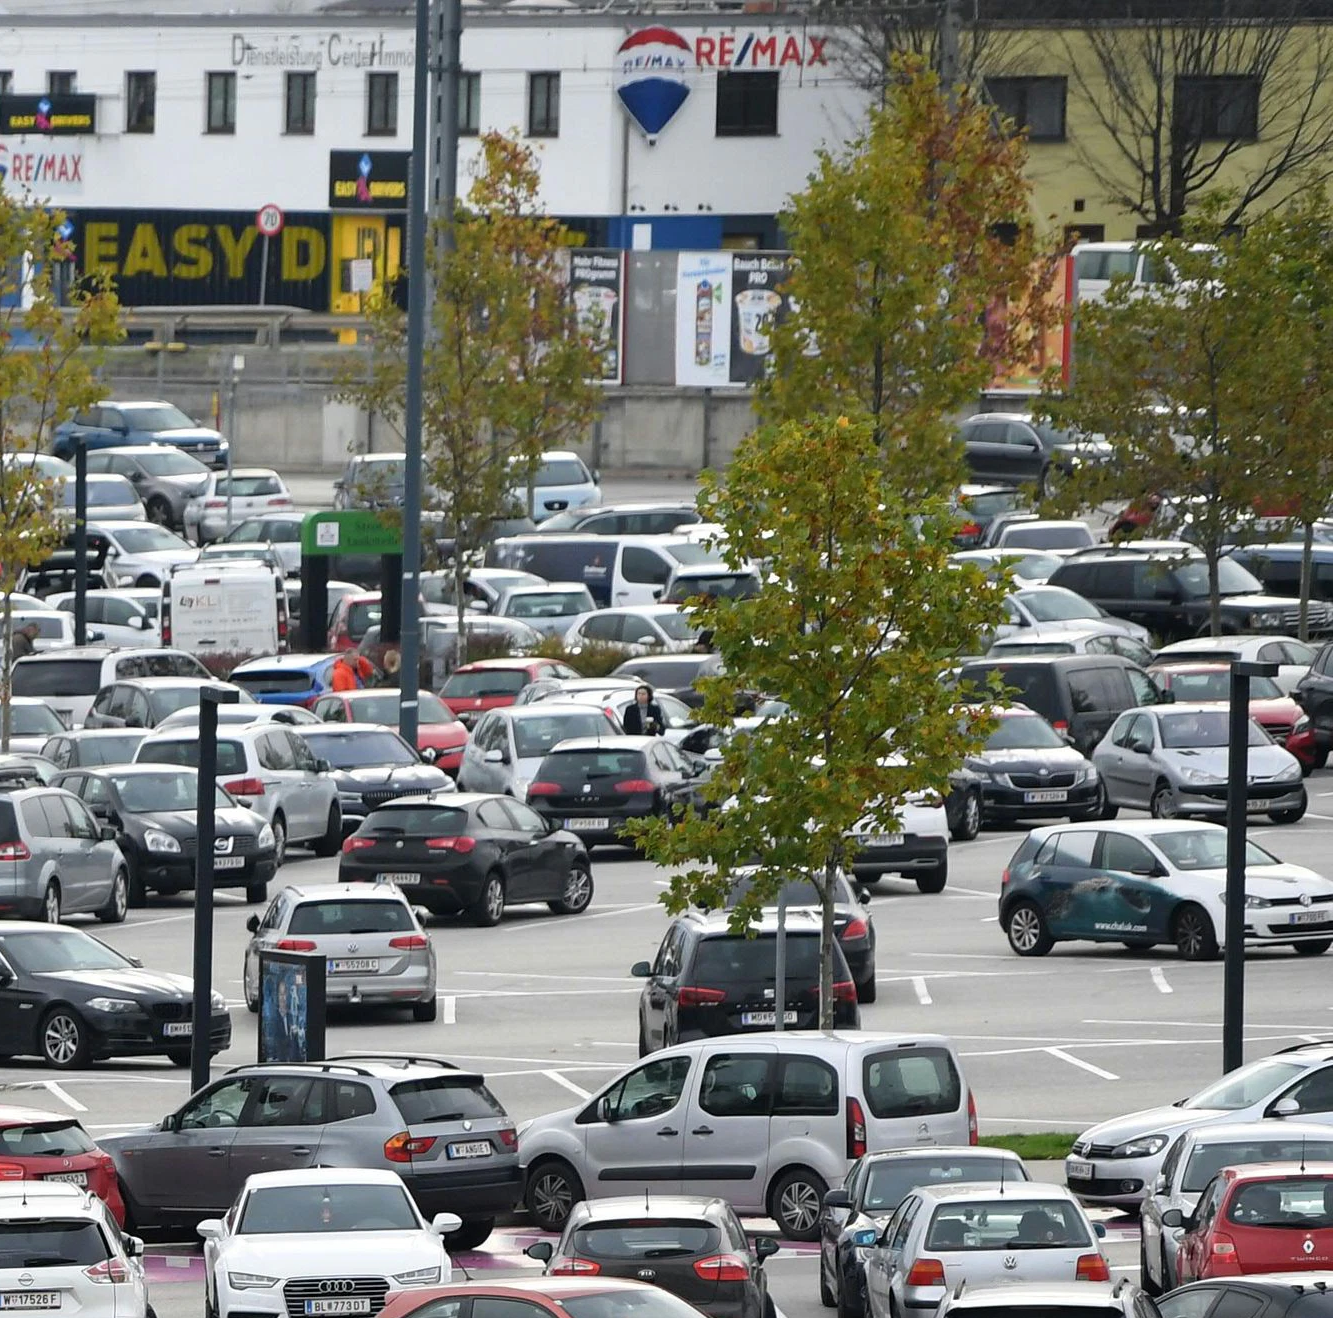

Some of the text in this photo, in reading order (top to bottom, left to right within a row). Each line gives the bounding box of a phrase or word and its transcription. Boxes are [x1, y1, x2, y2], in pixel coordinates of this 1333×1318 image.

[695, 33, 829, 66] RE/MAX
[13, 153, 82, 182] RE/MAX
[263, 213, 278, 227] 70
[84, 222, 259, 280] EASY
[4, 1296, 11, 1304] W
[20, 1295, 49, 1304] 17526
[315, 1301, 326, 1311] BL
[333, 1300, 352, 1311] 773
